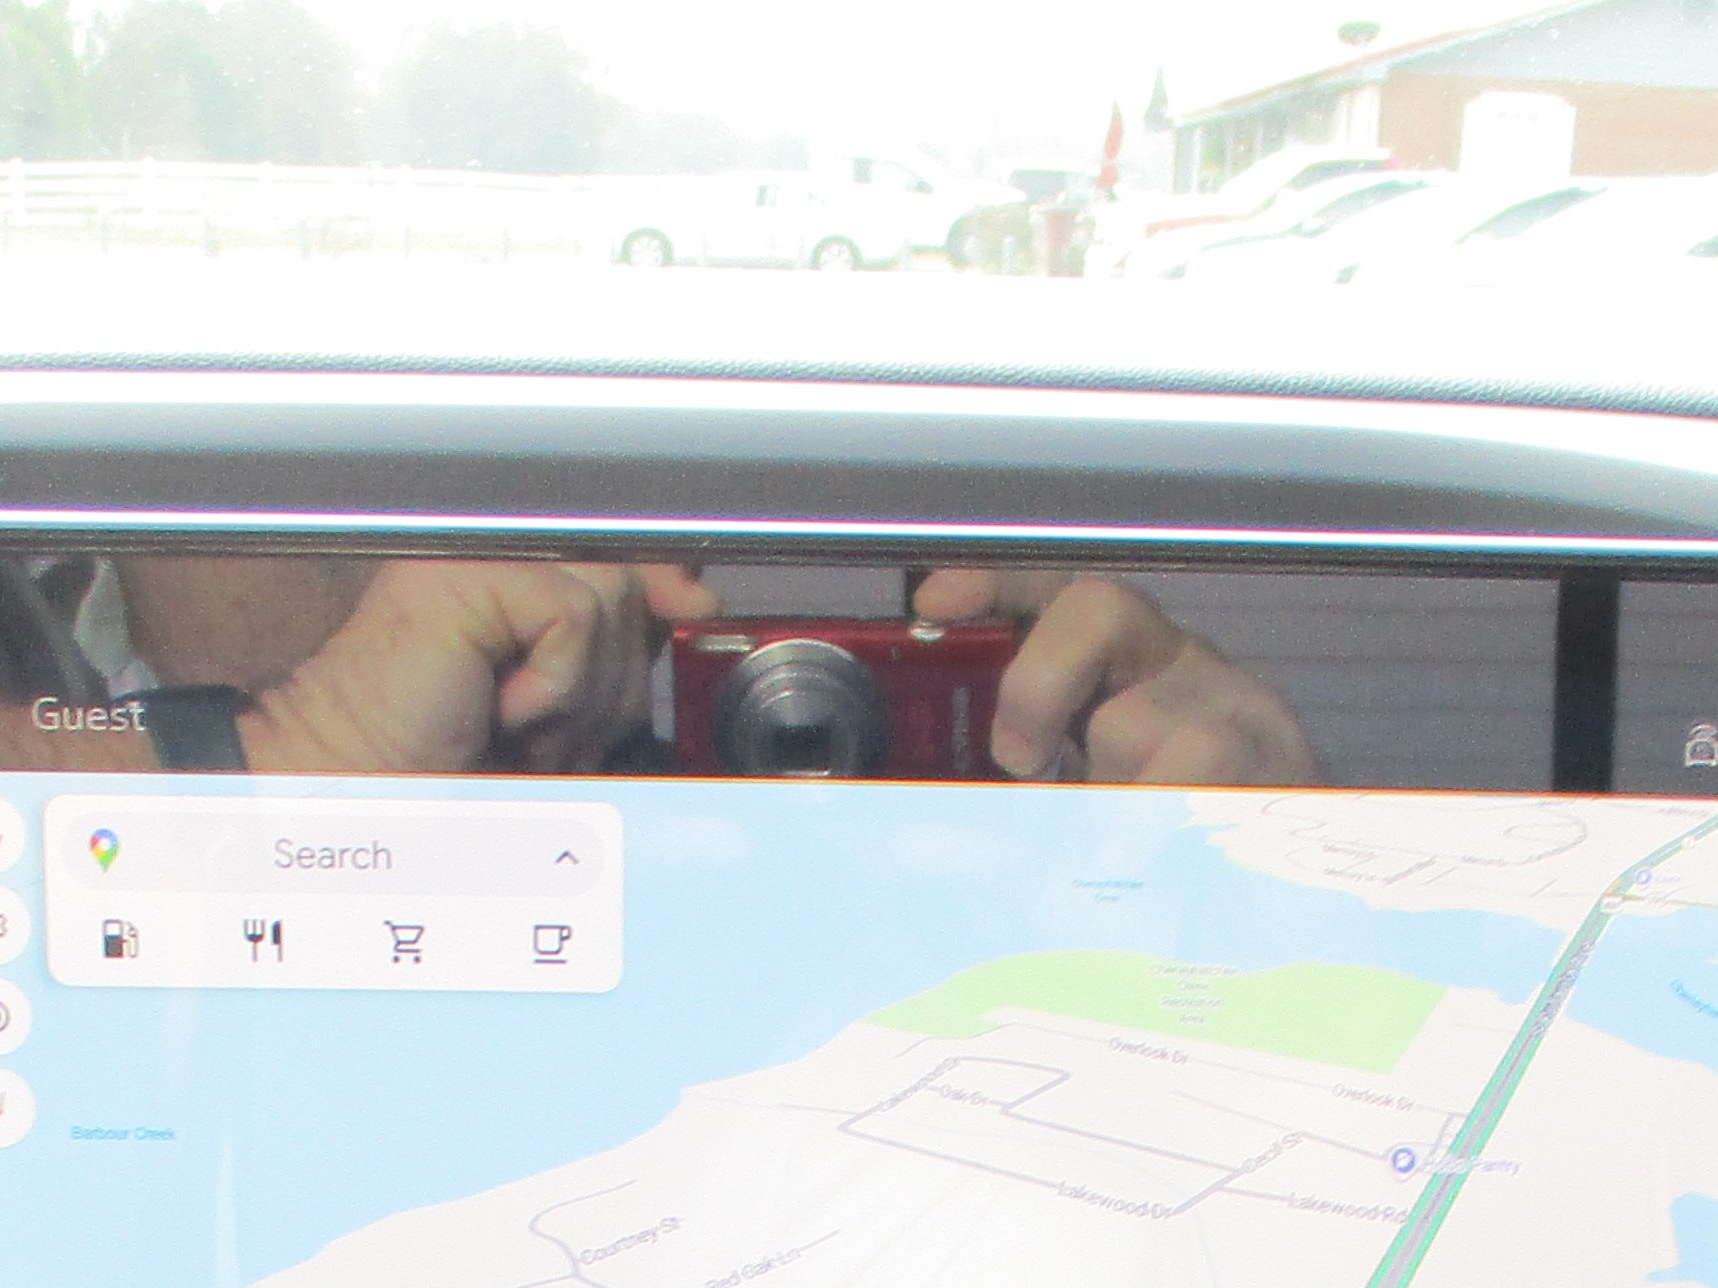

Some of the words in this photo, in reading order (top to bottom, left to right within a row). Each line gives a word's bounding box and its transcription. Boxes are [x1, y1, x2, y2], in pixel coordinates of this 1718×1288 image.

[32, 696, 146, 733] Guest
[273, 839, 393, 874] Search
[132, 1125, 176, 1141] Creek
[579, 1227, 658, 1266] Courtney
